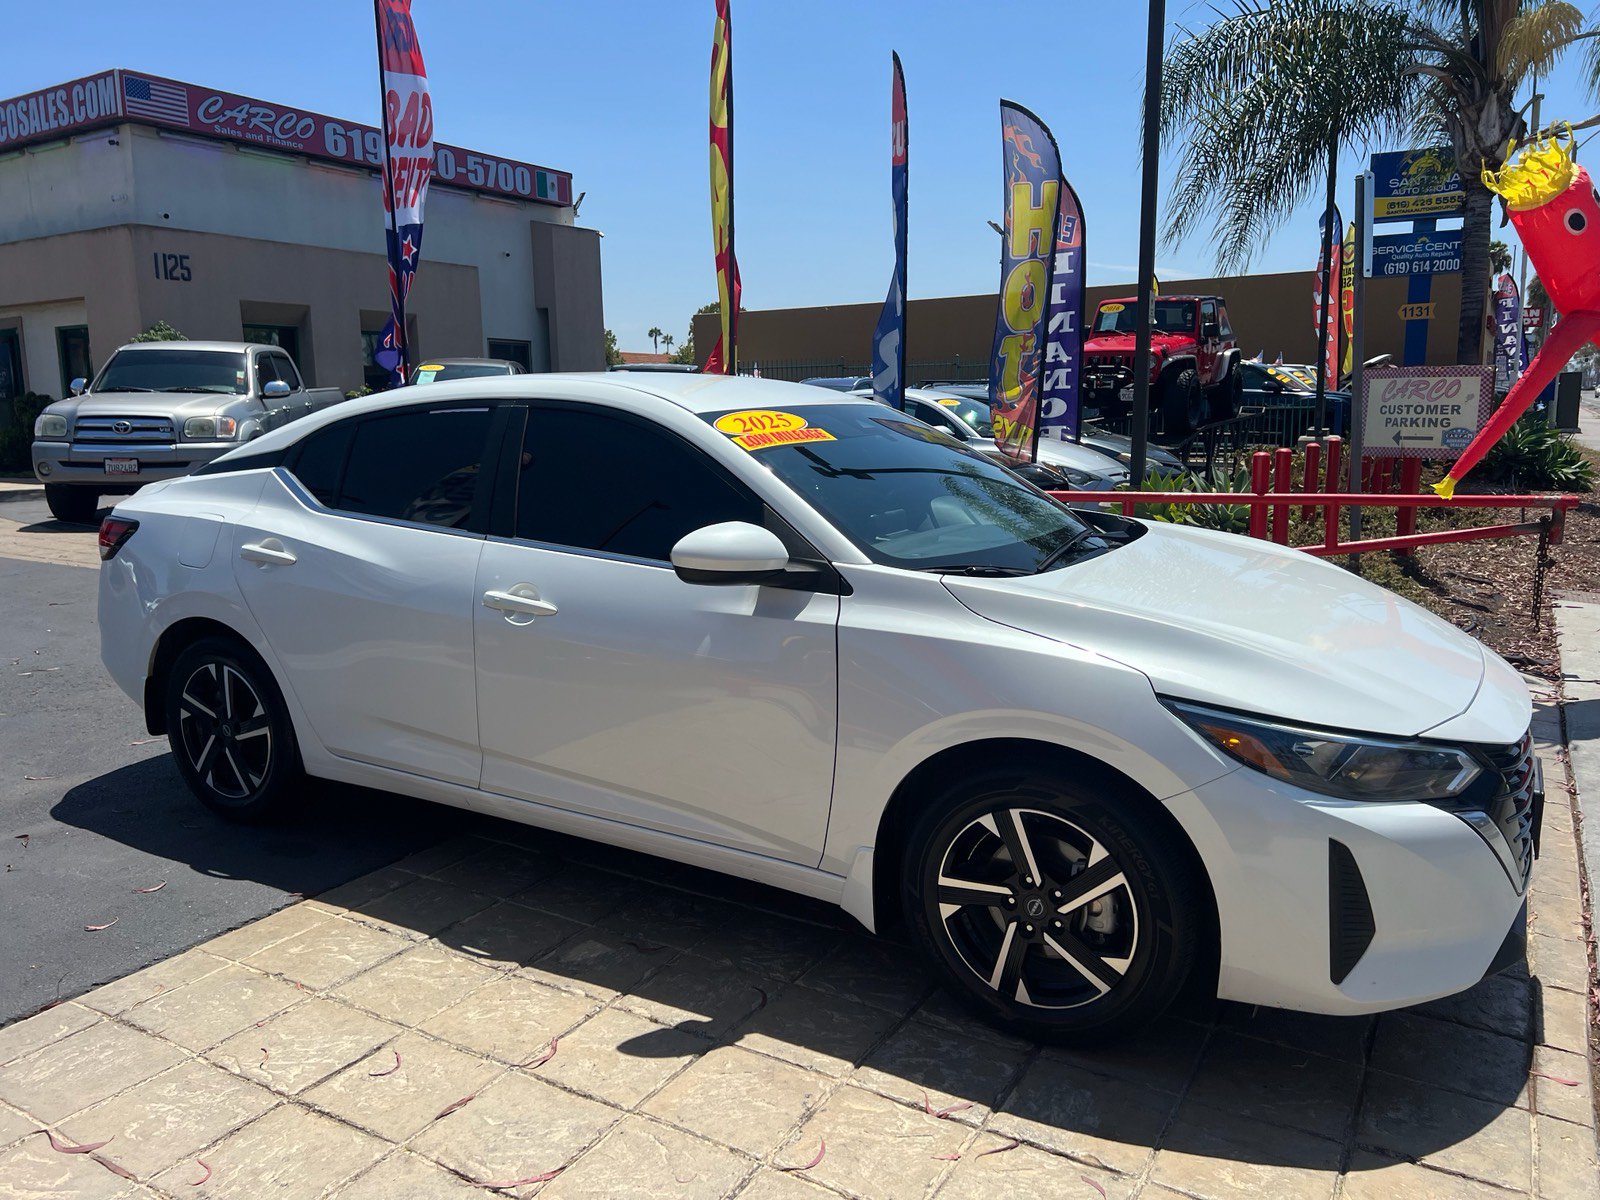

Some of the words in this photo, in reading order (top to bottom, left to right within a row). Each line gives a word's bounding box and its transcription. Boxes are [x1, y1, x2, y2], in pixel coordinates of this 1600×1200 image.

[197, 96, 315, 139] CARCO
[214, 125, 242, 138] Sales
[246, 132, 264, 143] and
[266, 135, 304, 149] Finance
[1392, 187, 1420, 195] AUTO
[1387, 200, 1409, 210] (619)
[1373, 243, 1422, 255] SERVICE
[1392, 252, 1413, 260] Quality
[1431, 250, 1454, 258] Repairs
[153, 252, 192, 281] 1125
[1384, 261, 1409, 275] (619)
[1412, 260, 1430, 273] 614
[1433, 259, 1460, 272] 2000
[1000, 180, 1059, 403] HOT
[1401, 306, 1430, 318] 1131
[1381, 378, 1461, 402] CARCO
[1380, 404, 1461, 415] CUSTOMER
[733, 414, 792, 433] 2025
[1385, 417, 1451, 428] PARKING
[740, 432, 775, 447] LOW
[770, 428, 827, 442] MILEAGE
